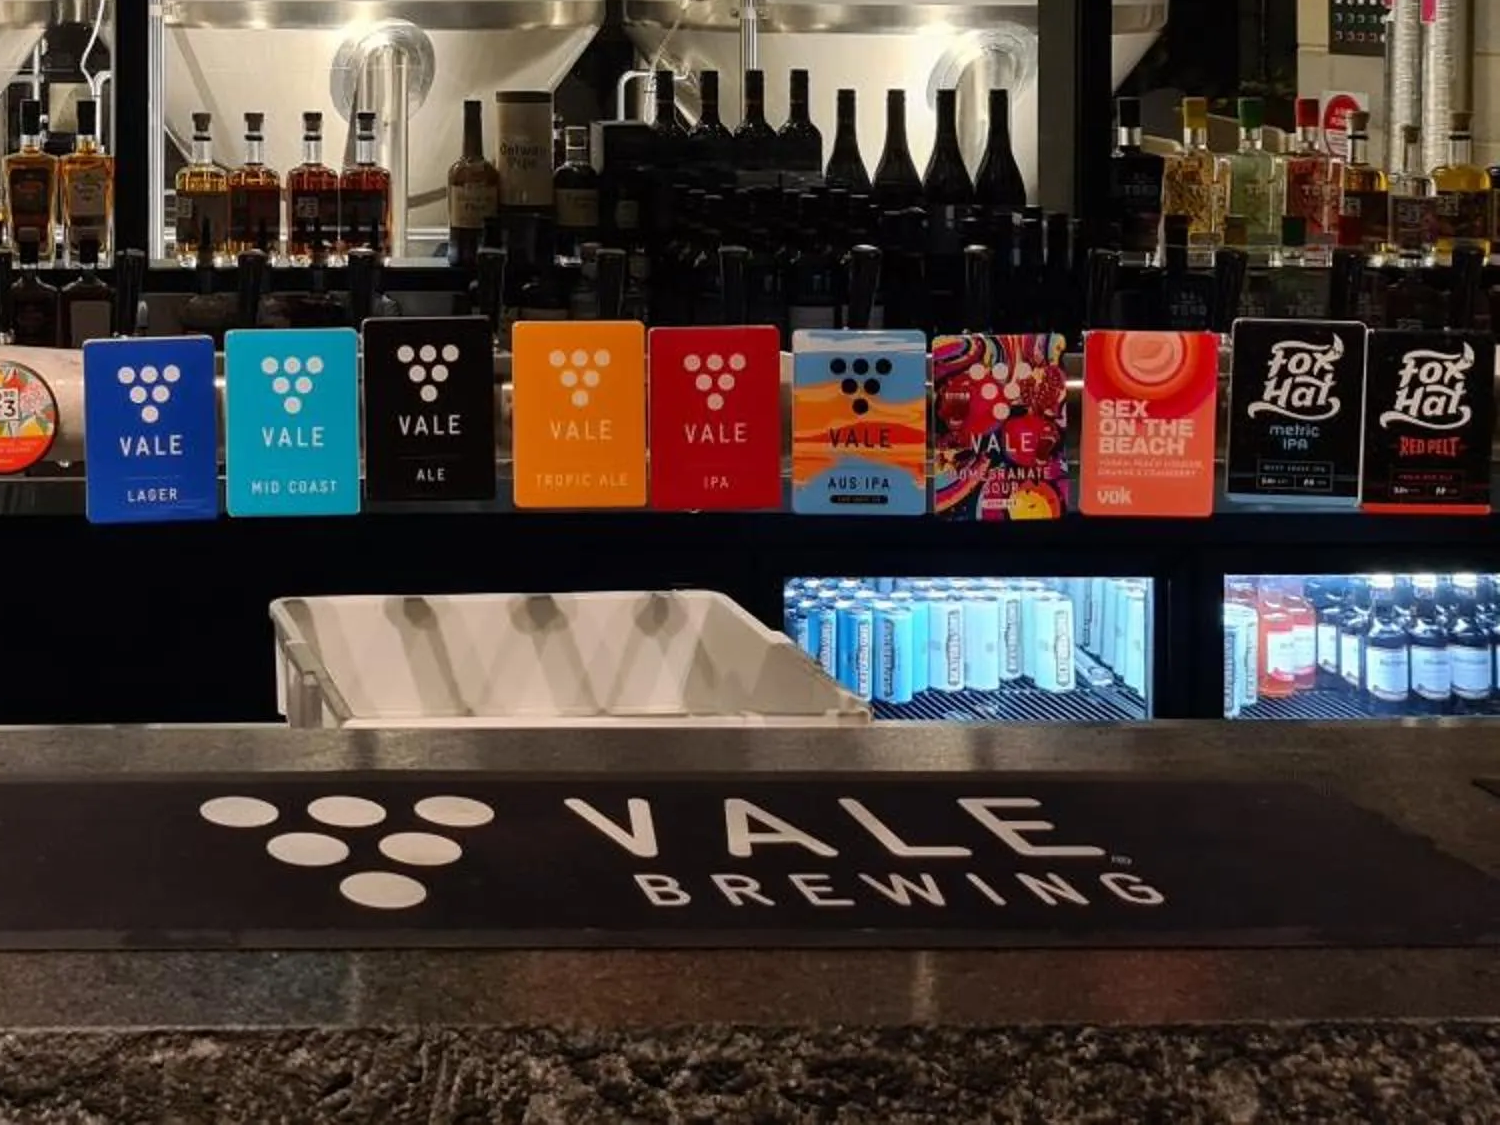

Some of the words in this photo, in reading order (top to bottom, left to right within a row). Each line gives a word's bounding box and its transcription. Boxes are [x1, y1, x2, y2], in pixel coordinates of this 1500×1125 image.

[1099, 398, 1149, 417] SEX
[399, 415, 461, 435] VALE
[550, 420, 612, 440] VALE
[684, 423, 748, 443] VALE
[1100, 418, 1136, 437] ON
[1143, 418, 1194, 438] THE
[120, 435, 183, 456] VALE
[262, 426, 325, 447] VALE
[828, 428, 892, 448] VALE
[971, 432, 1035, 454] VALE
[1099, 436, 1186, 455] BEACH
[1282, 438, 1308, 451] IPA
[1399, 437, 1425, 457] RED
[1428, 437, 1461, 457] PELT
[416, 468, 446, 482] ALE
[536, 474, 590, 487] TROPIC
[599, 474, 628, 487] ALE
[703, 476, 729, 489] IPA
[828, 476, 857, 490] AUS
[865, 476, 890, 490] IPA
[127, 488, 178, 503] LAGER
[251, 480, 280, 495] MID
[288, 479, 337, 494] COAST
[563, 797, 1106, 857] VALE
[633, 872, 1164, 907] BREWING
